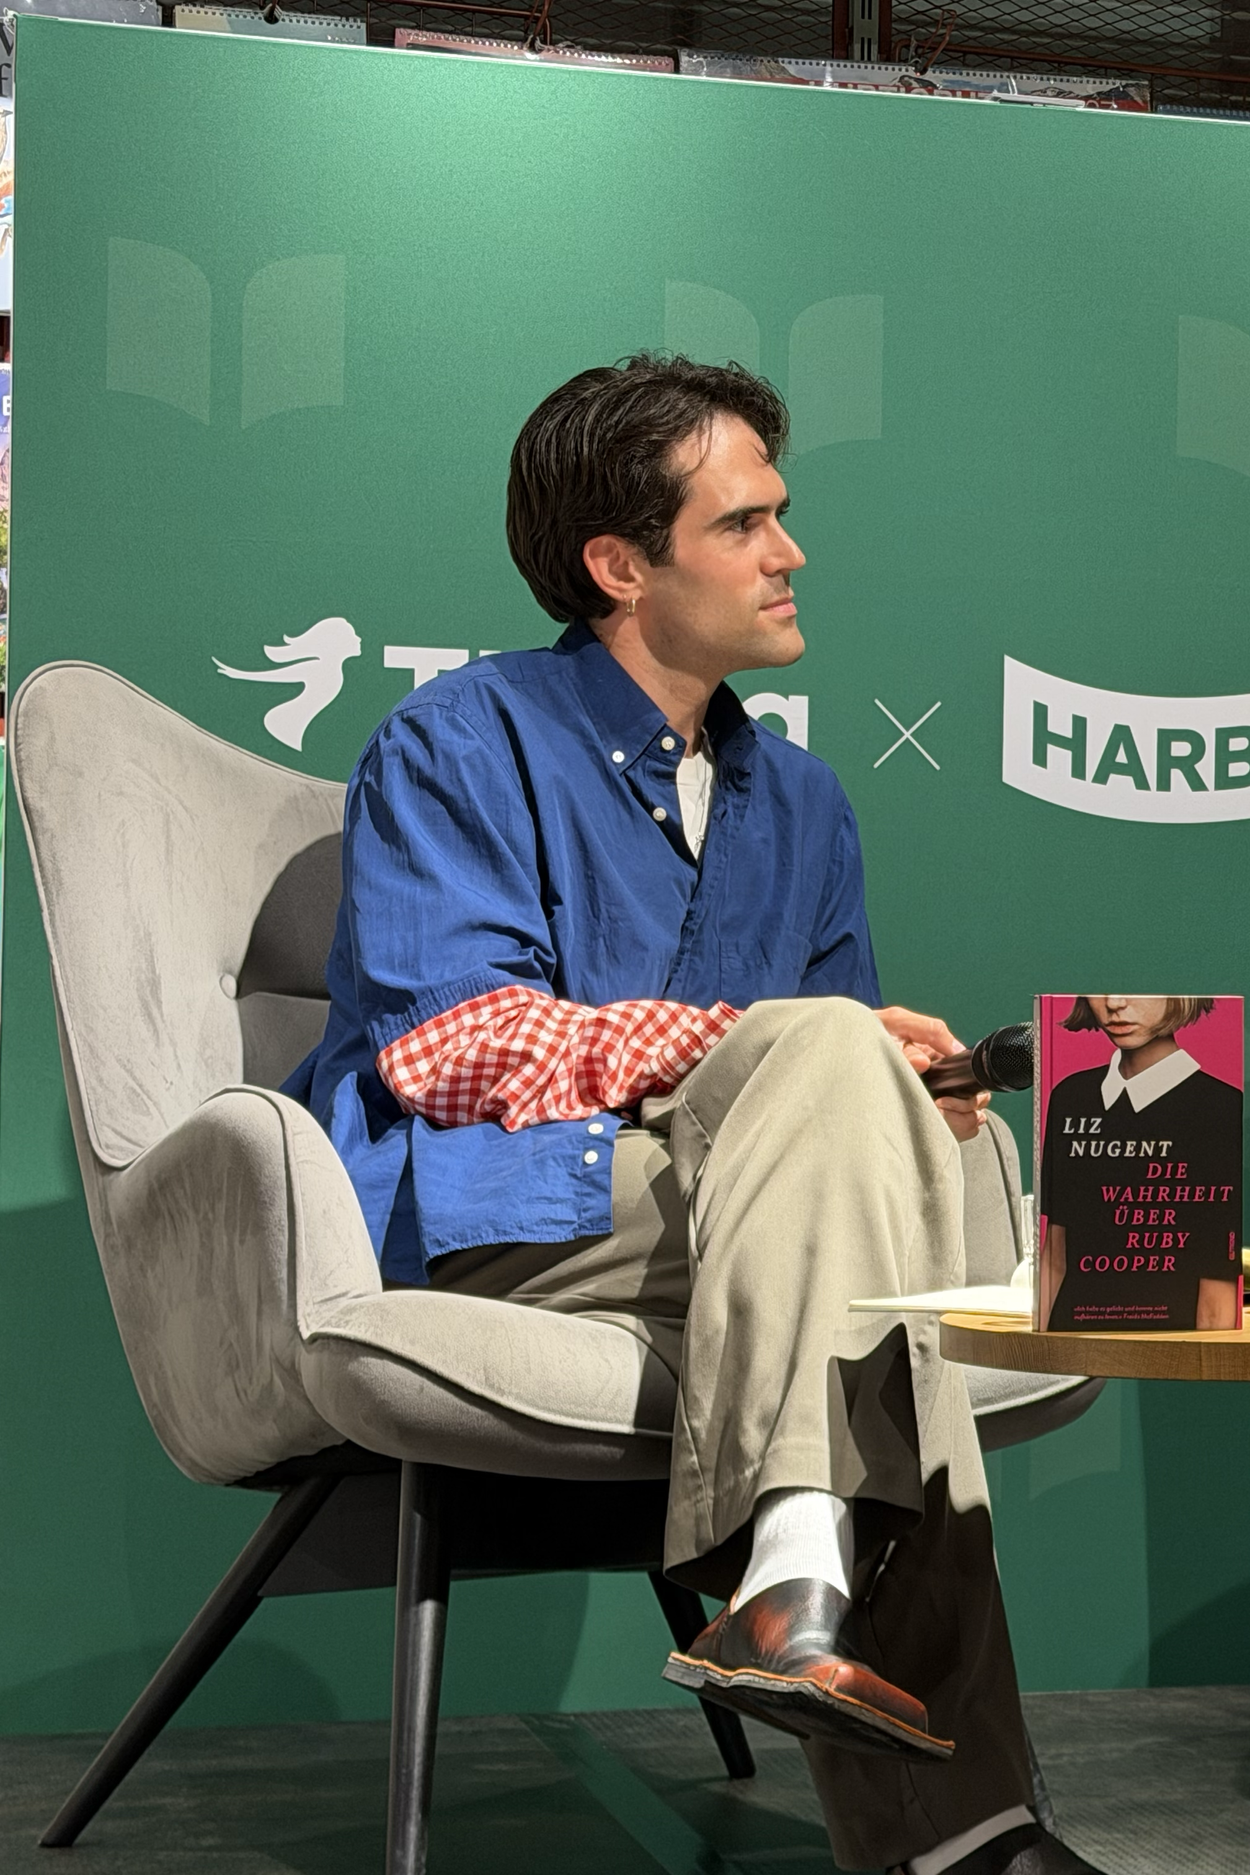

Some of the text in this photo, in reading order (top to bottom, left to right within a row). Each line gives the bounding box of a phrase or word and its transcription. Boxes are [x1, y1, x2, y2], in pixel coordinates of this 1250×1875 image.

[1063, 1117, 1102, 1134] LIZ
[1069, 1140, 1172, 1157] NUGENT
[1146, 1163, 1188, 1179] DIE
[1101, 1186, 1233, 1202] WAHRHEIT
[1114, 1206, 1177, 1225] ÜBER
[1126, 1232, 1190, 1249] RUBY
[1079, 1255, 1176, 1272] COOPER
